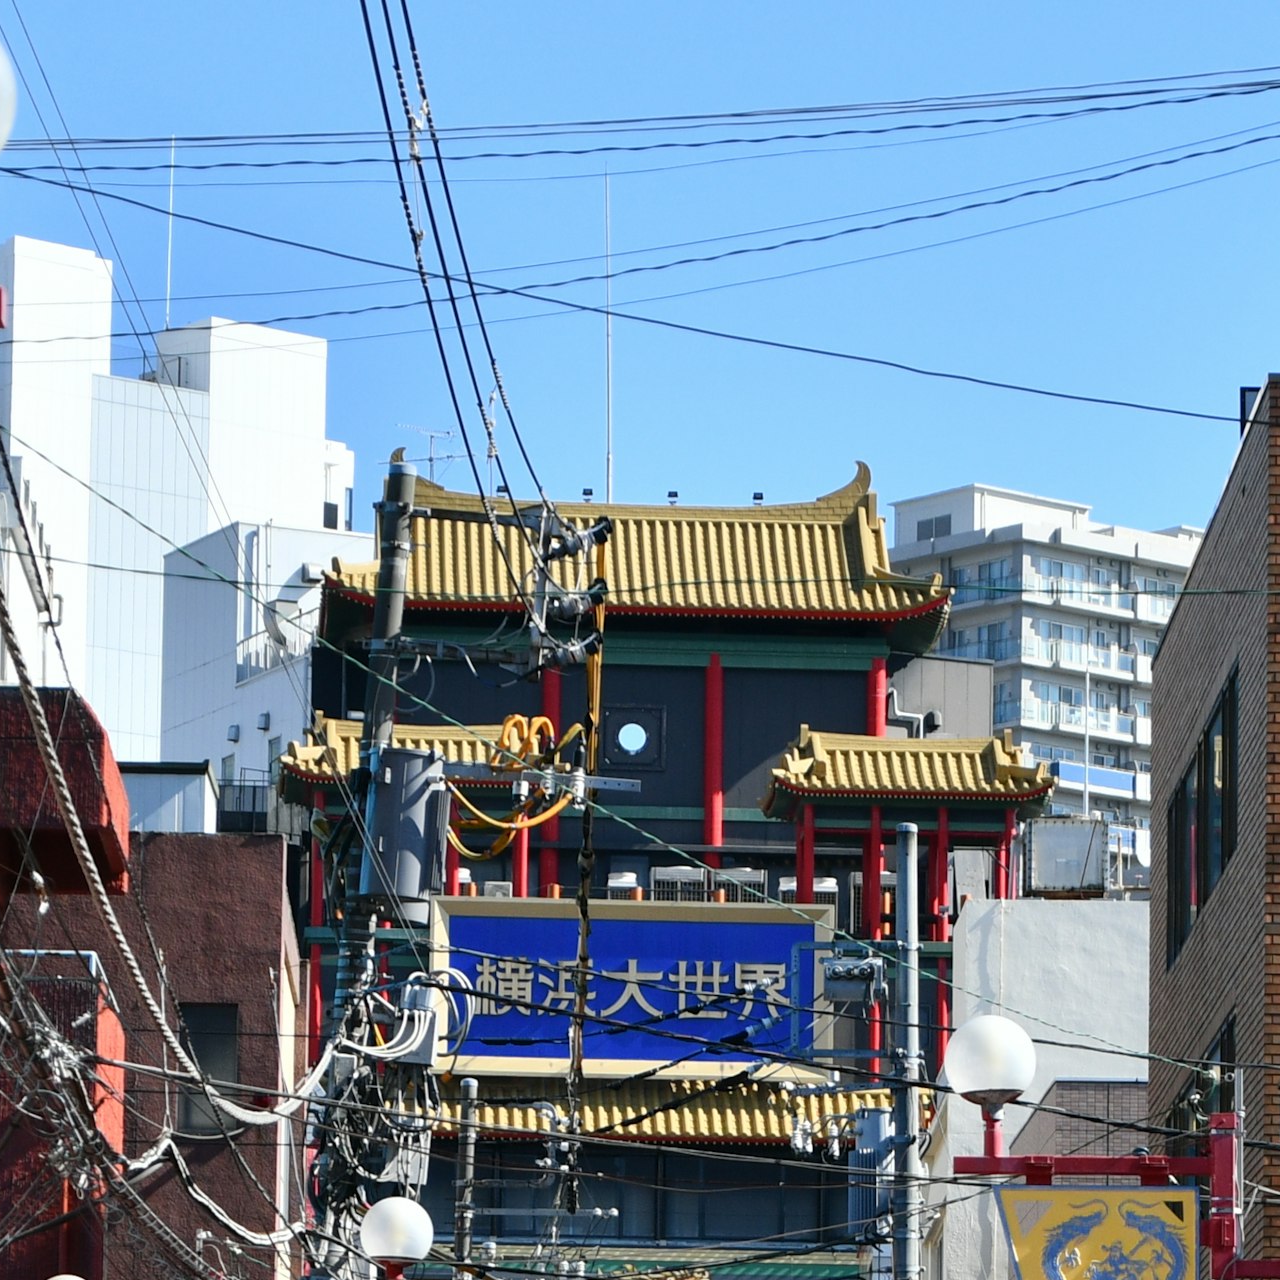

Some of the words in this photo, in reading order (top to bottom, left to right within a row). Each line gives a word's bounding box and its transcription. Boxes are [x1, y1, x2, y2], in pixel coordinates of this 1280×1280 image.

[474, 957, 790, 1020] 横浜大世界
